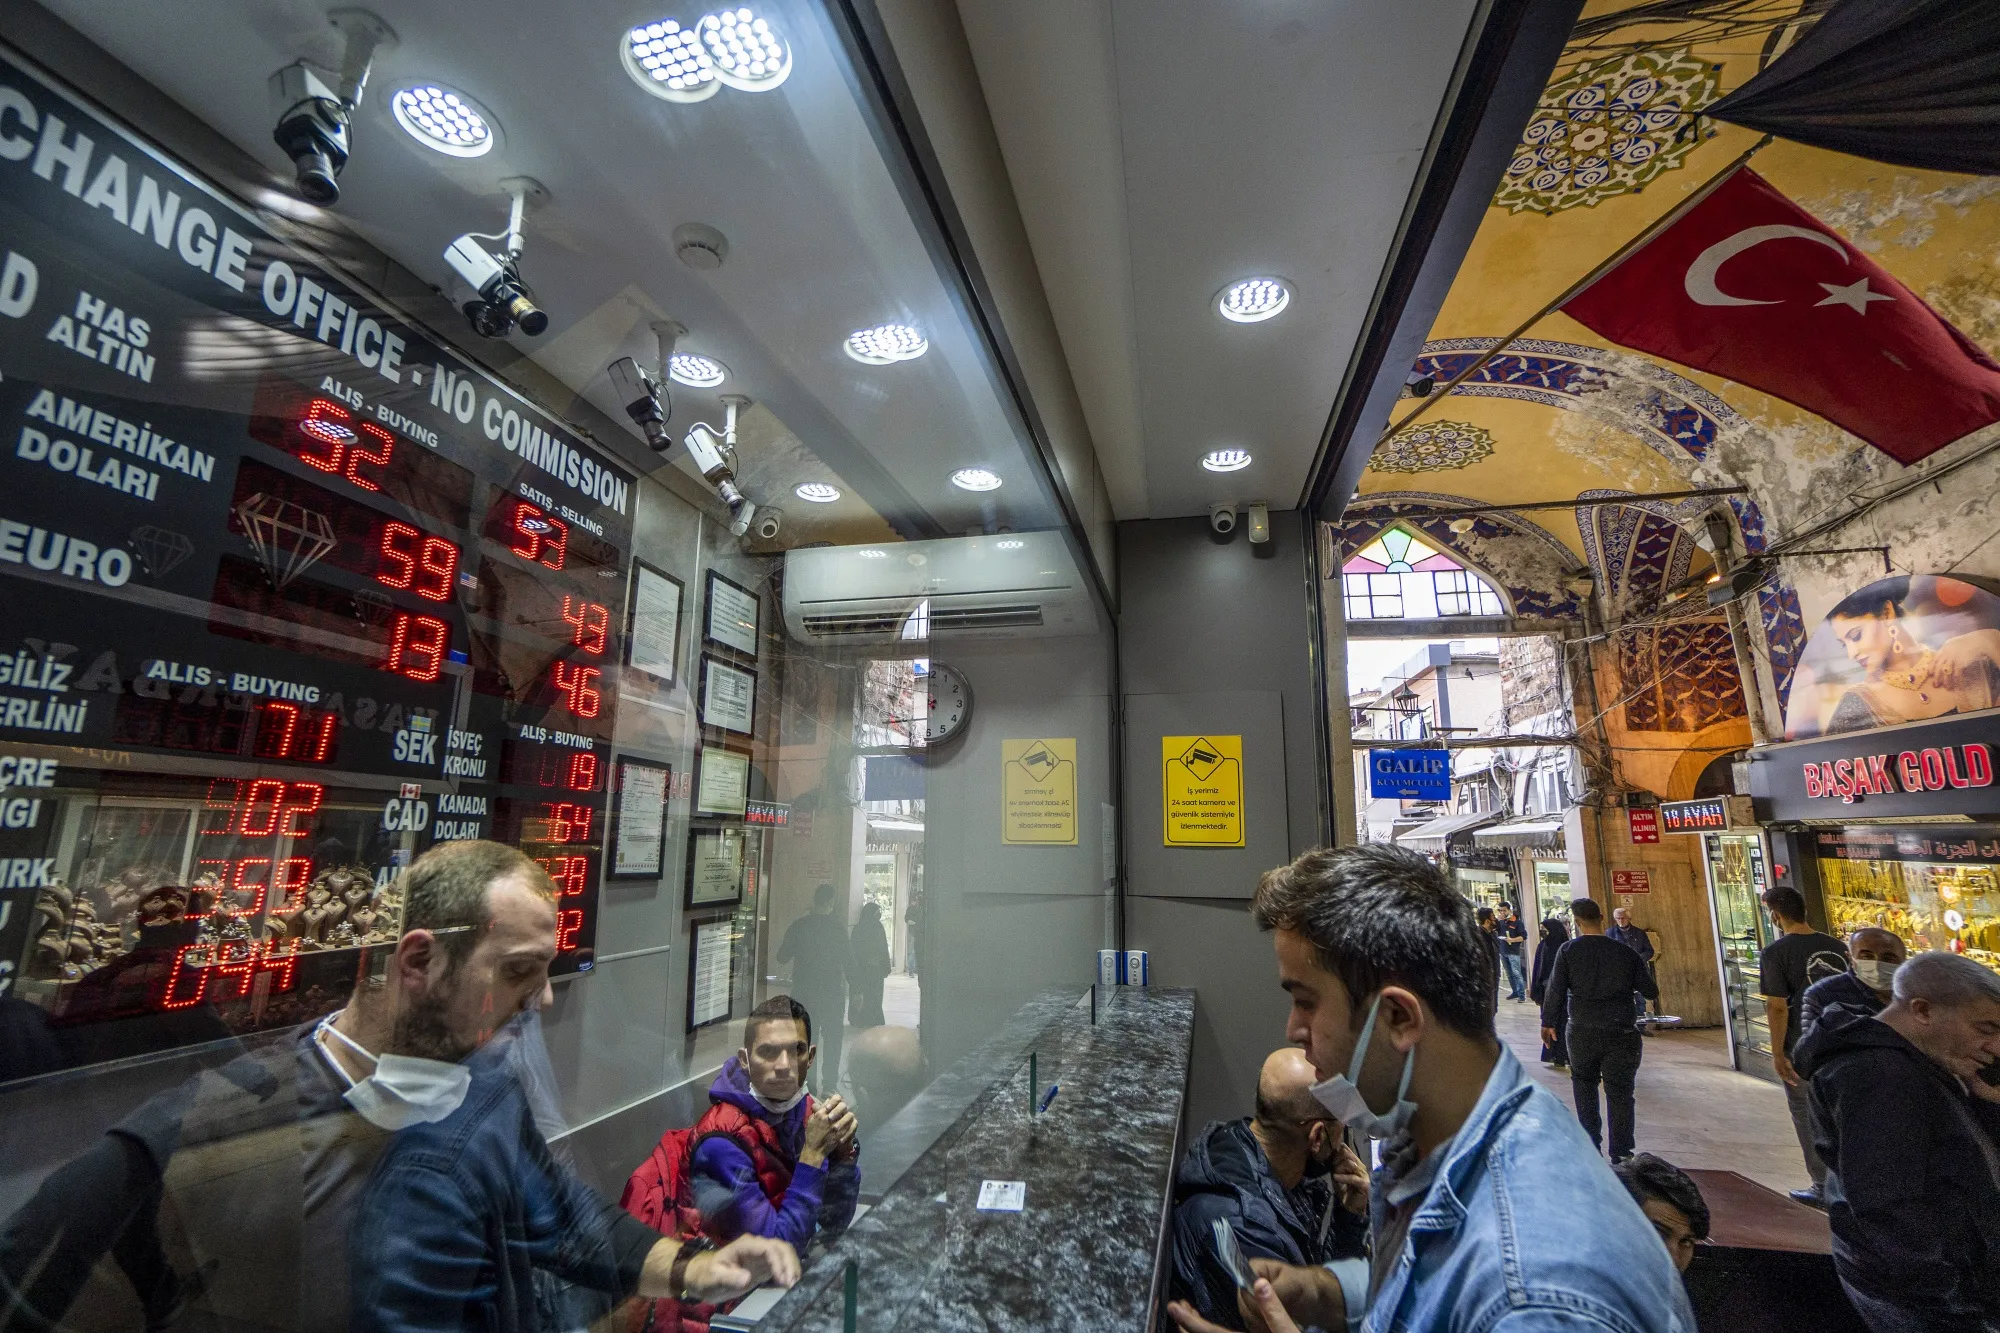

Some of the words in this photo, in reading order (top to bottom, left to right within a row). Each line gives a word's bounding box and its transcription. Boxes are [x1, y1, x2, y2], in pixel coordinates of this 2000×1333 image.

[0, 85, 253, 293] CHANGE
[263, 260, 406, 385] OFFICE
[430, 362, 476, 424] NO
[483, 398, 628, 516] COMMISSION
[74, 290, 151, 348] HAS
[46, 314, 156, 383] ALTIN
[26, 388, 216, 483] AMERİKAN
[320, 375, 364, 411] ALIŞ
[376, 404, 438, 449] BUYING
[17, 425, 160, 502] DOLARI
[300, 398, 394, 491] 52
[511, 503, 569, 571] 53
[519, 482, 552, 512] SATIŞ
[561, 505, 603, 537] SELLING
[0, 517, 132, 588] EURO
[377, 521, 457, 601] 59
[389, 615, 447, 681] 13
[563, 594, 608, 654] 43
[232, 672, 321, 703] BUYING
[556, 661, 602, 718] 46
[943, 674, 948, 682] 1
[952, 685, 959, 693] 2
[956, 700, 963, 708] 3
[266, 702, 335, 761] 71
[393, 729, 439, 765] SEK
[447, 724, 483, 756] İSVEÇ
[520, 724, 546, 744] ALIŞ
[555, 730, 593, 750] BUYING
[940, 725, 946, 733] 5
[951, 714, 957, 722] 4
[443, 754, 487, 778] KRONU
[1195, 786, 1219, 795] yerimiz
[1376, 756, 1443, 775] GALİP
[1377, 779, 1443, 787] KUYUMCULUK
[1803, 754, 1895, 804] BAŞAK
[1899, 743, 1994, 793] GOLD
[384, 798, 430, 832] CAD
[438, 793, 488, 816] KANADA
[434, 820, 481, 840] DOLARI
[1171, 811, 1199, 819] güvenlik
[1632, 813, 1654, 821] ALTIN
[163, 937, 300, 1009] 044
